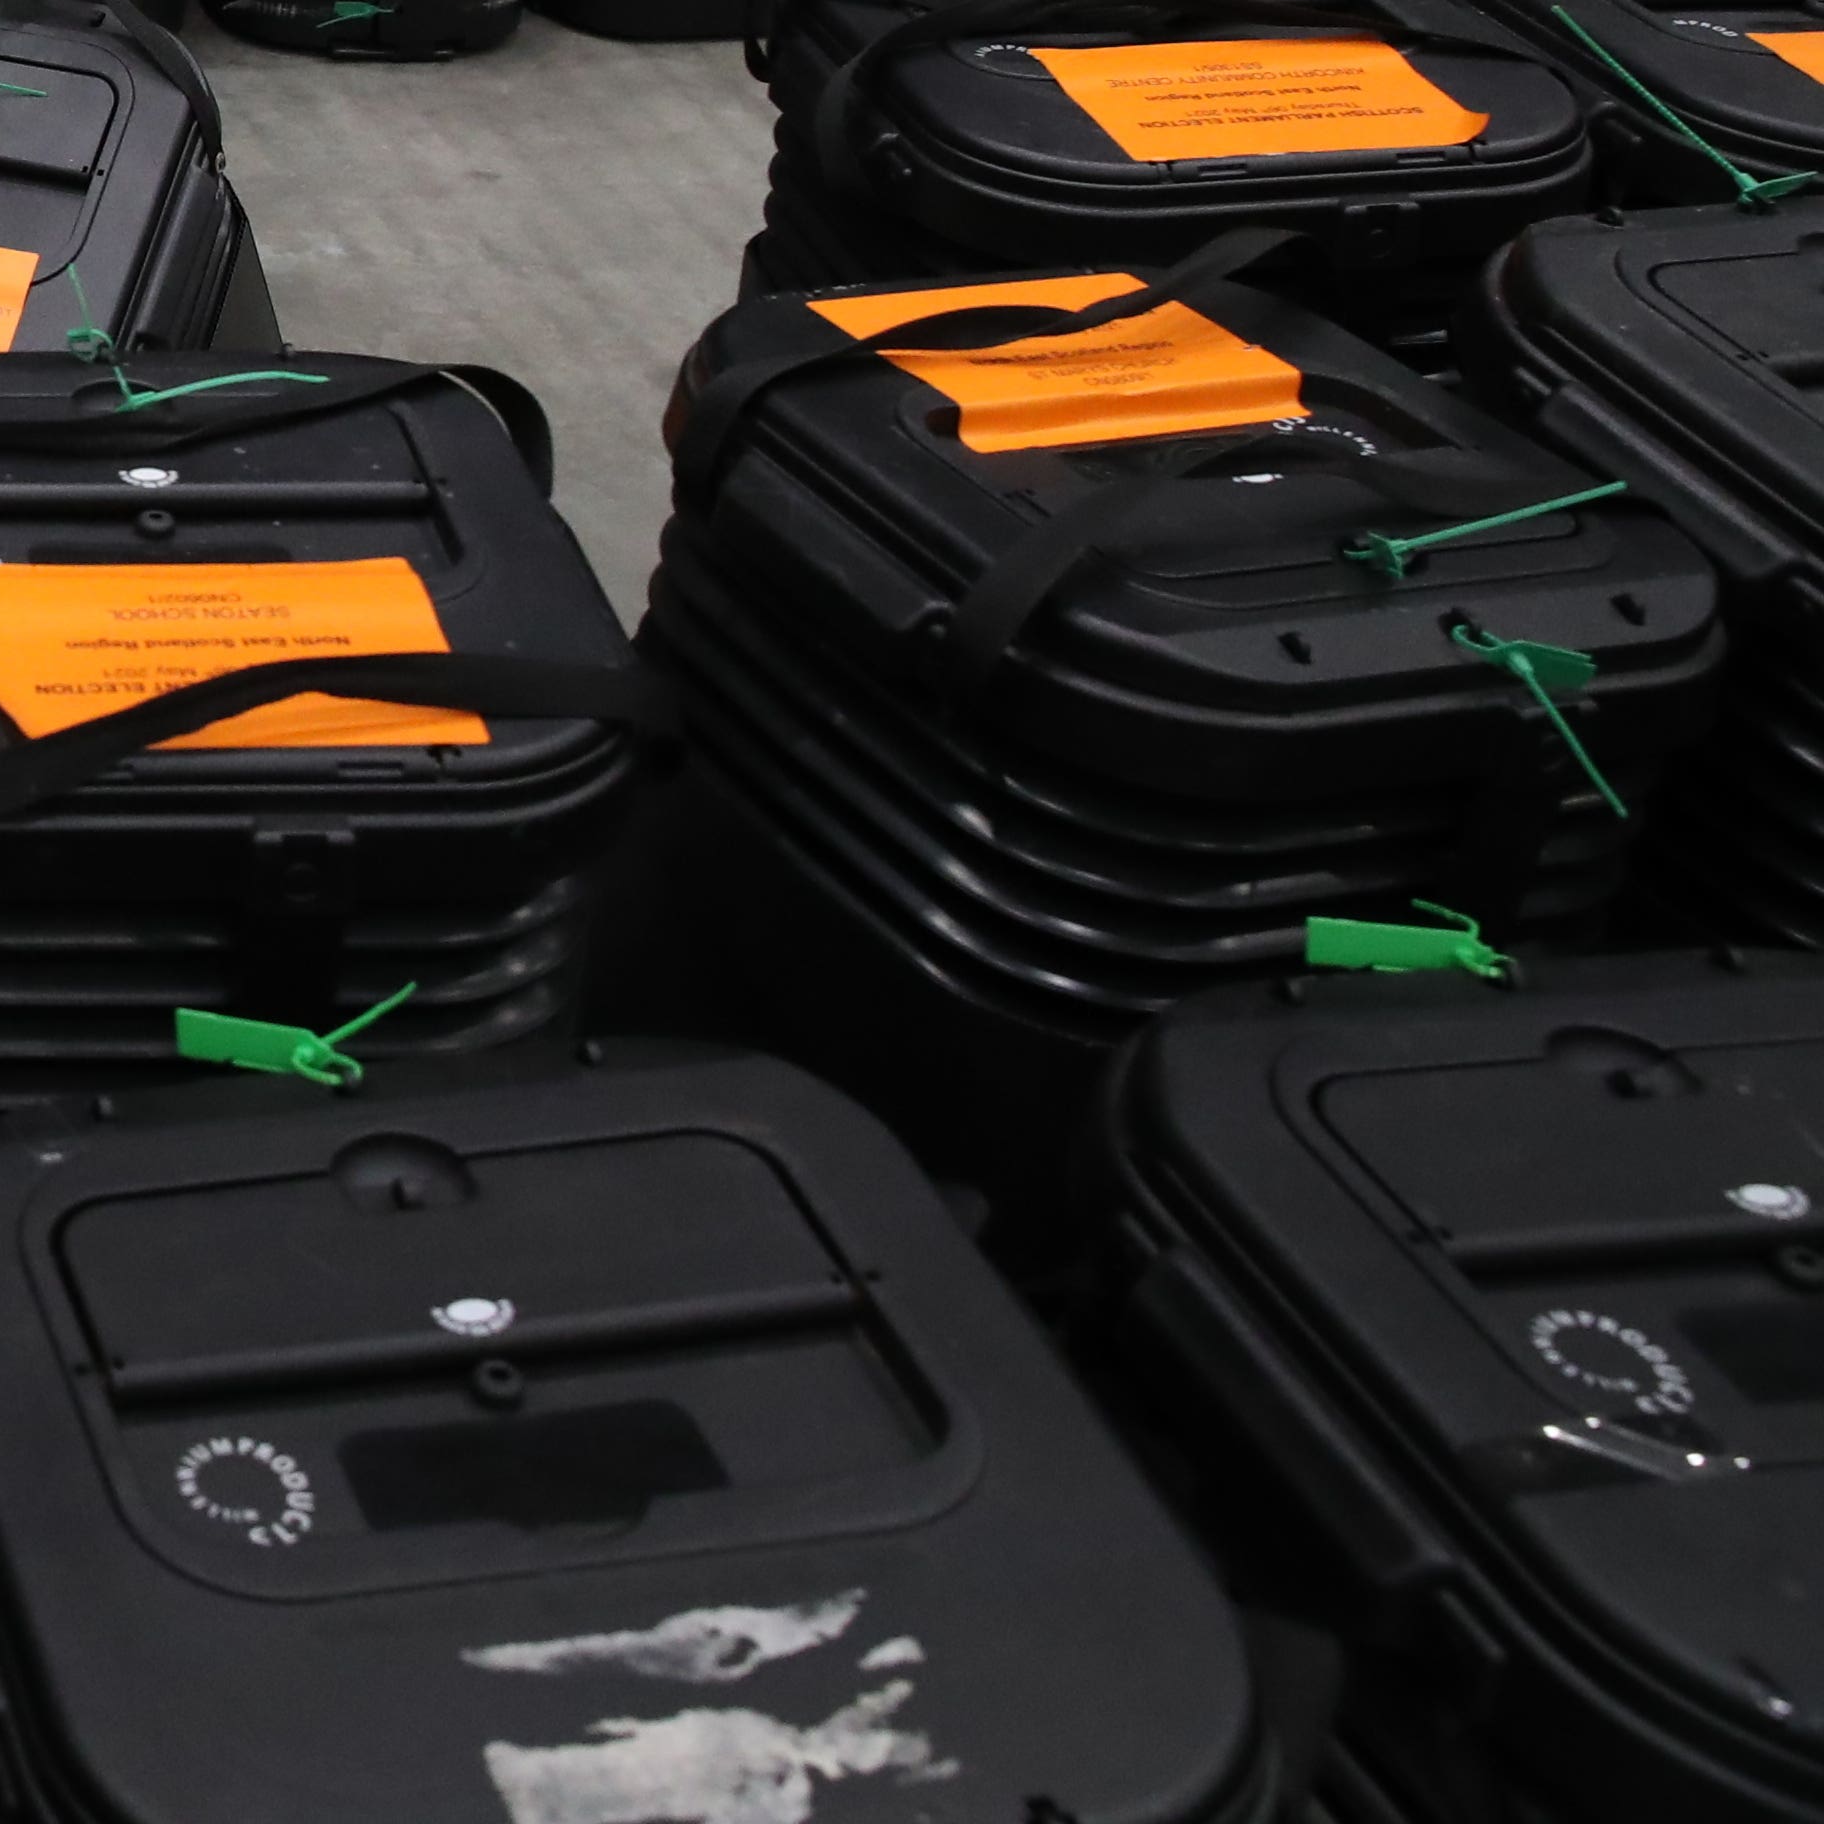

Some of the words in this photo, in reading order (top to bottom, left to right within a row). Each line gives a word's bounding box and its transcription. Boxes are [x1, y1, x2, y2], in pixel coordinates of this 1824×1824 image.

[1105, 76, 1173, 89] CENTRE
[1316, 83, 1362, 95] North
[1145, 91, 1202, 103] Region
[1204, 87, 1276, 101] Scotland
[1277, 85, 1313, 97] East
[1229, 110, 1334, 126] PARLIAMENT
[1340, 105, 1424, 119] SCOTTISH
[1138, 117, 1224, 130] ELECTION
[65, 638, 140, 651] Region
[144, 637, 236, 650] Scotland
[241, 637, 287, 648] East
[293, 635, 351, 646] North
[33, 681, 146, 696] ELECTION
